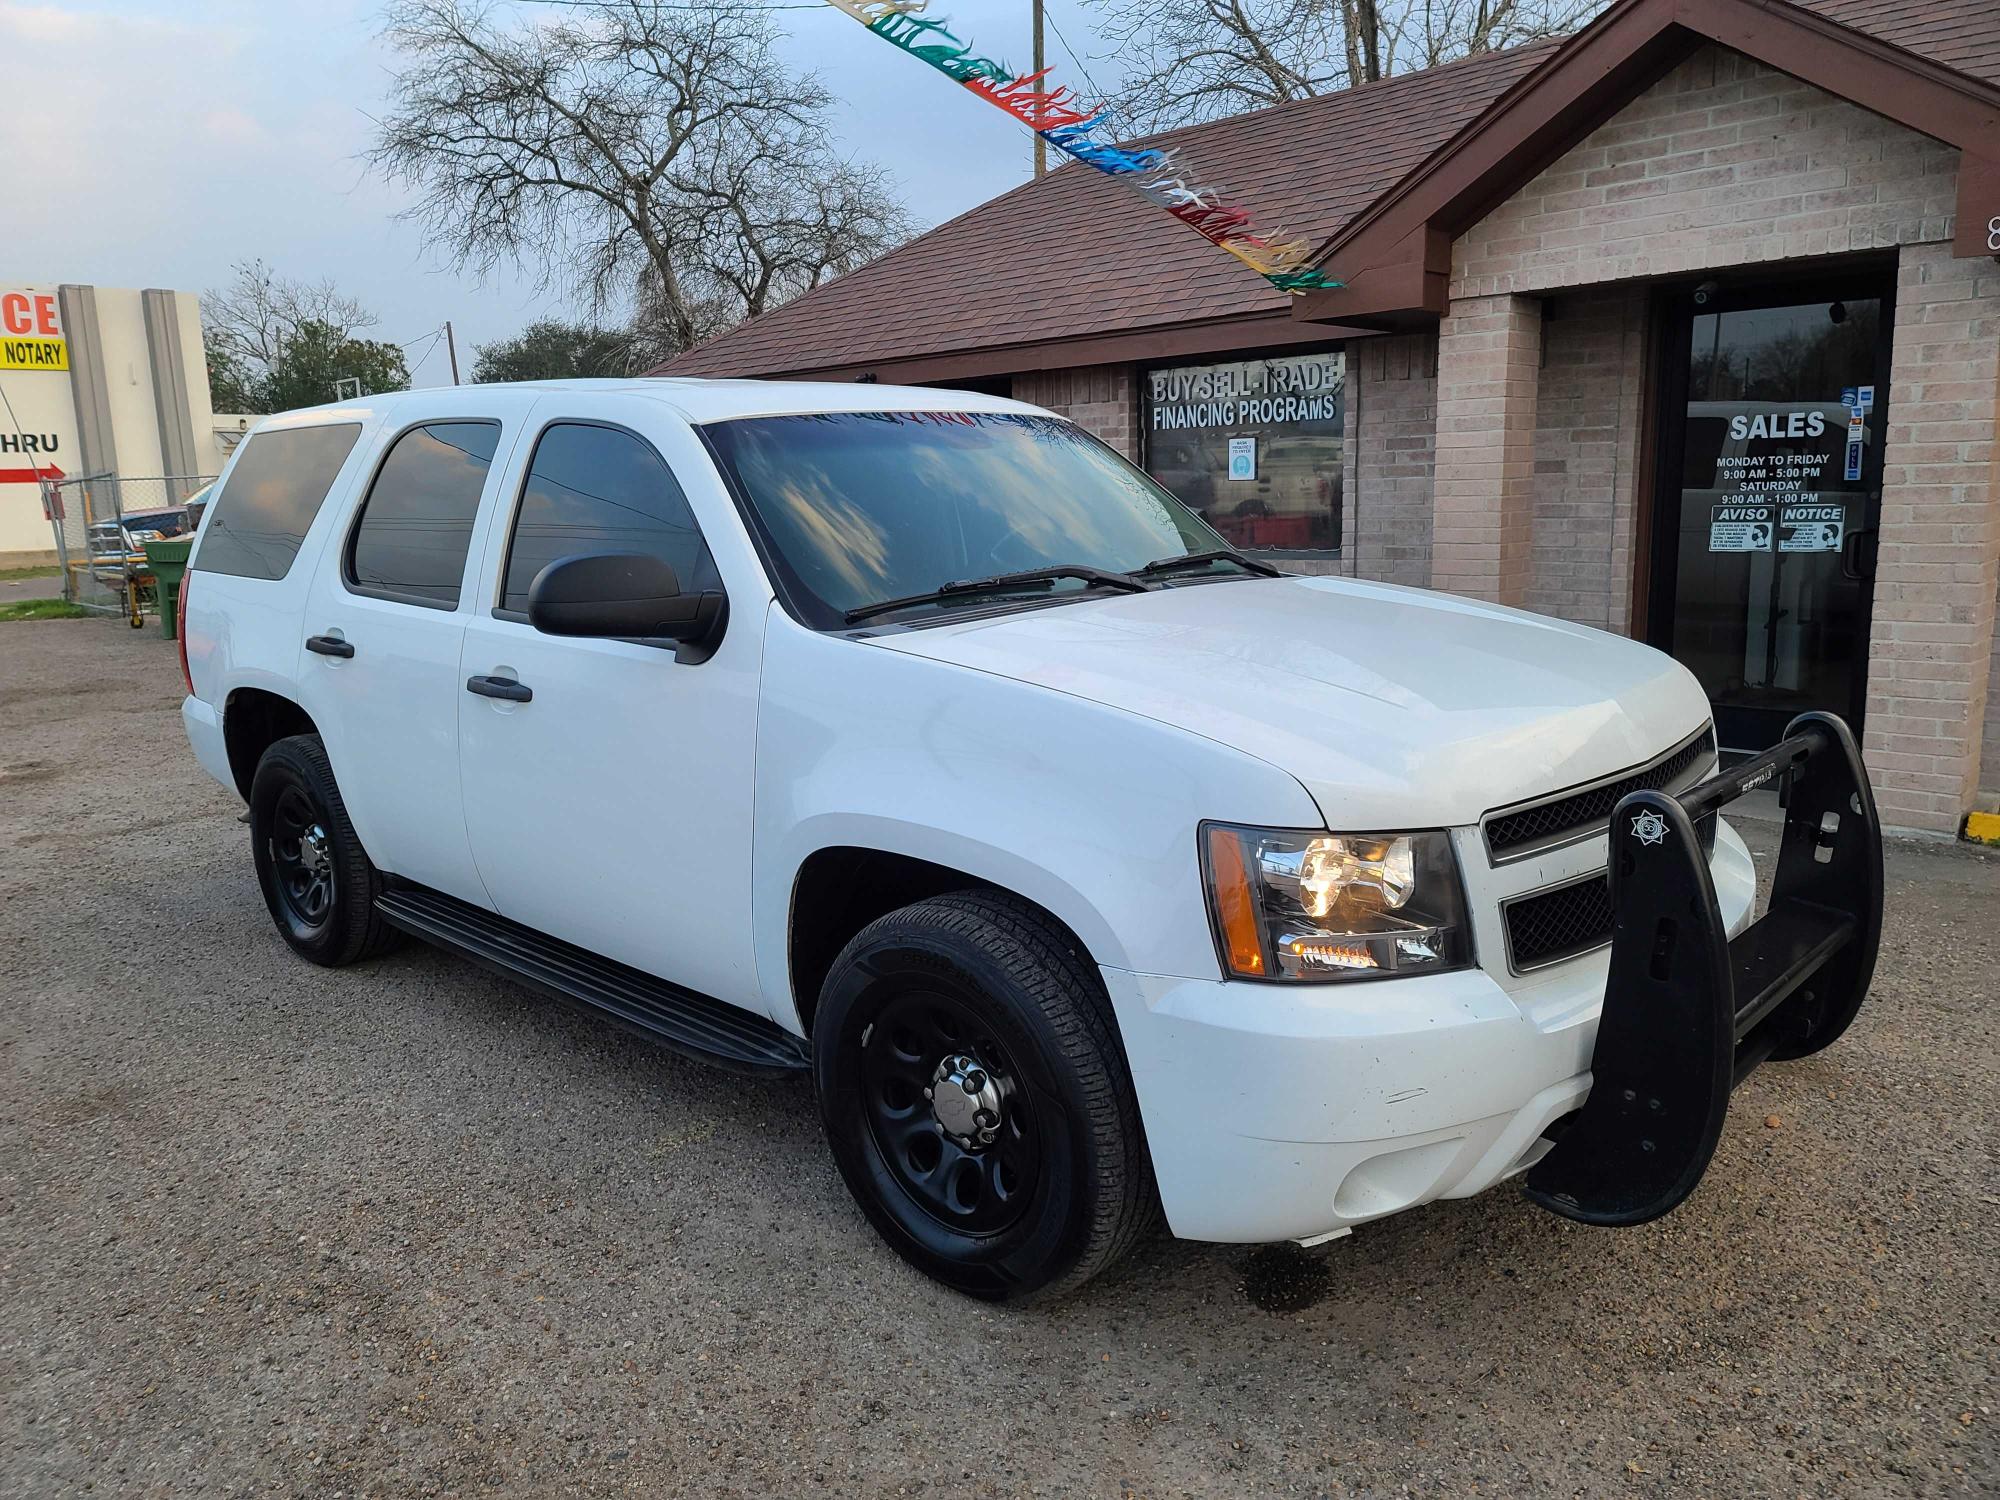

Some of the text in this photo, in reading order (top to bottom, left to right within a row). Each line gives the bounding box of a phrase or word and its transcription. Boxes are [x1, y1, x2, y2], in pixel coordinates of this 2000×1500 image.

[4, 341, 61, 365] NOTARY
[1153, 395, 1334, 430] FINANCING PROGRAMS
[1730, 411, 1825, 440] SALES
[1717, 454, 1830, 467] MONDAY TO FRIDAY
[1723, 470, 1746, 479] 9:00
[1748, 469, 1766, 479] AM
[1776, 468, 1799, 478] 5:00
[1802, 467, 1820, 477] PM
[1740, 481, 1802, 491] SATURDAY
[1722, 495, 1744, 504] 9:00
[1746, 494, 1764, 504] AM
[1774, 494, 1798, 503] 1:00
[1800, 493, 1818, 503] PM
[1718, 508, 1768, 520] AVISO
[1784, 508, 1842, 520] NOTICE
